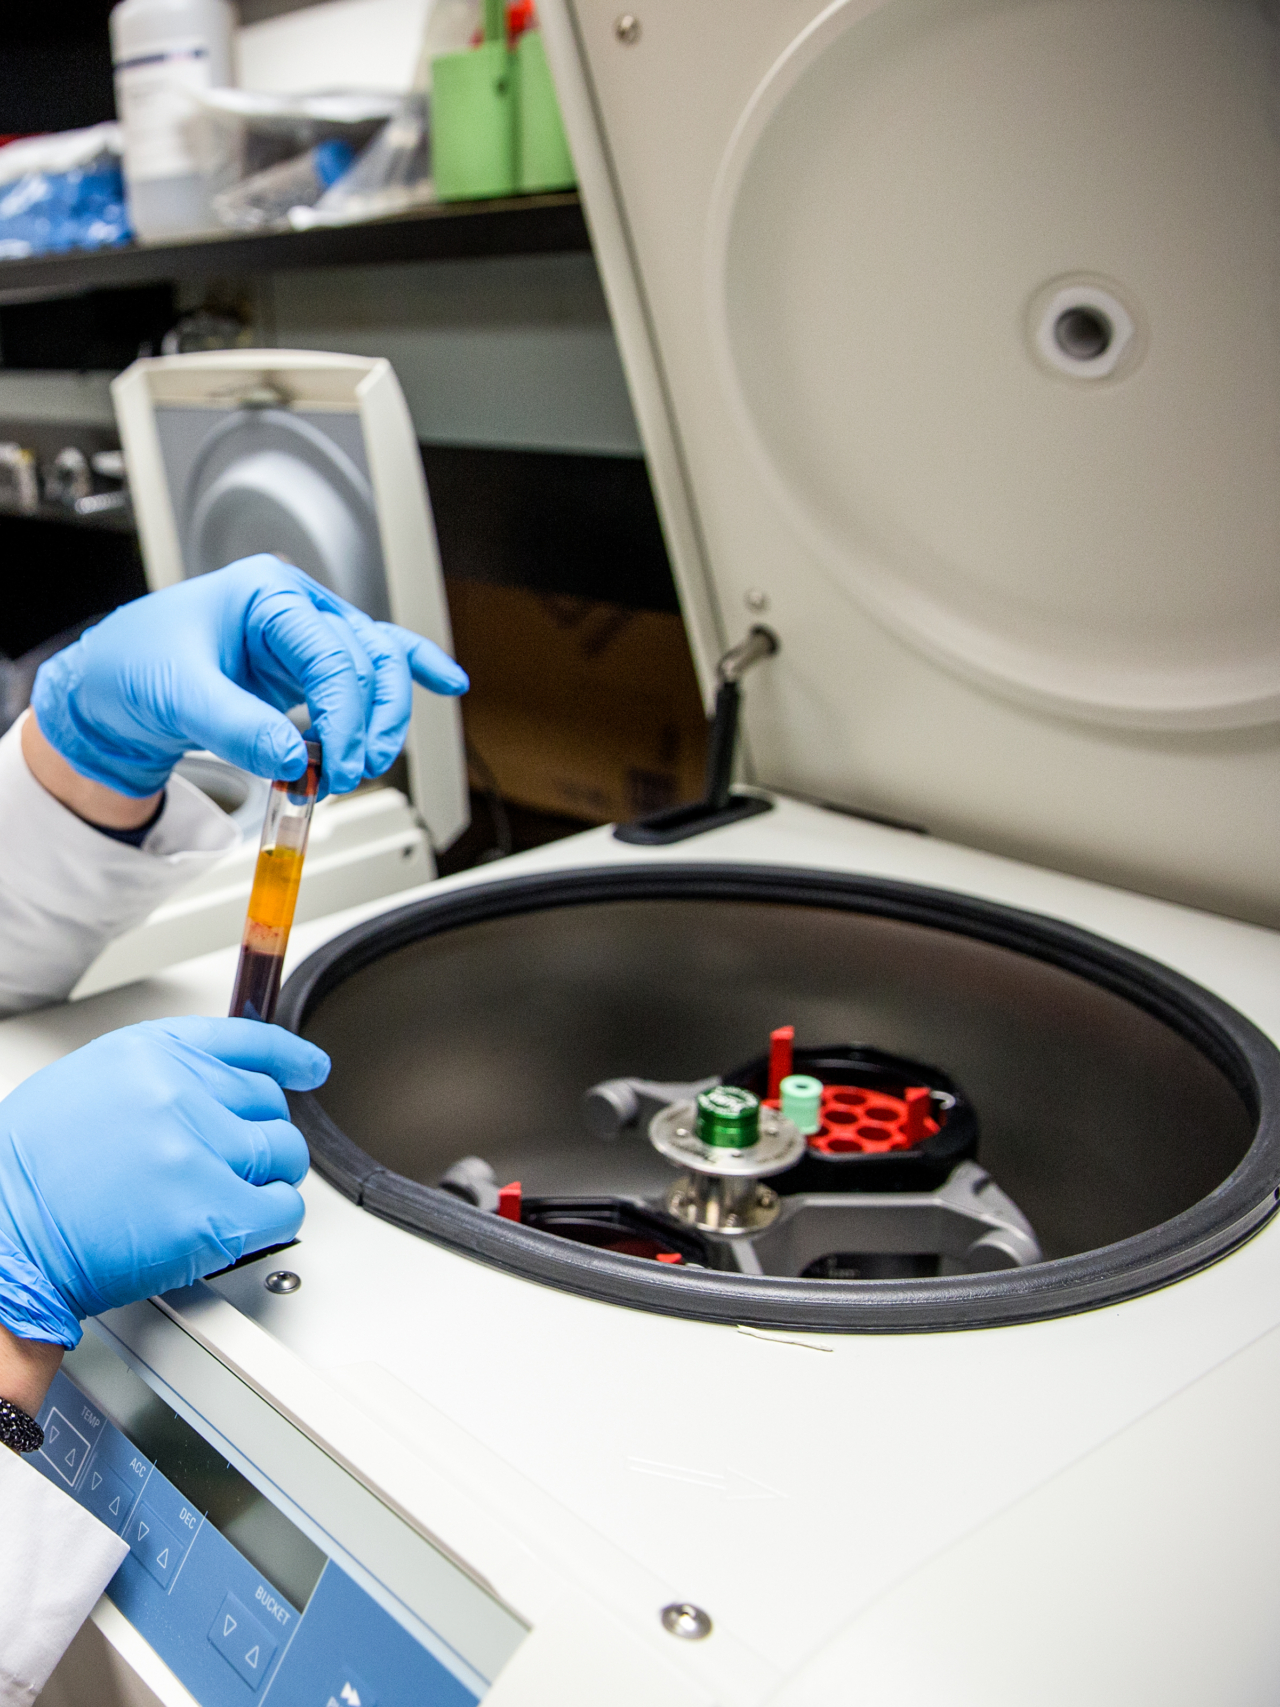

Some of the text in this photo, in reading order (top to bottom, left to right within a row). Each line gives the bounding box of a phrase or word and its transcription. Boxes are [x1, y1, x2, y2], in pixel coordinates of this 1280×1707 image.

[81, 1405, 100, 1428] TEMP
[129, 1457, 146, 1478] ACC
[179, 1507, 196, 1529] DEC
[255, 1585, 291, 1626] BUCKET
